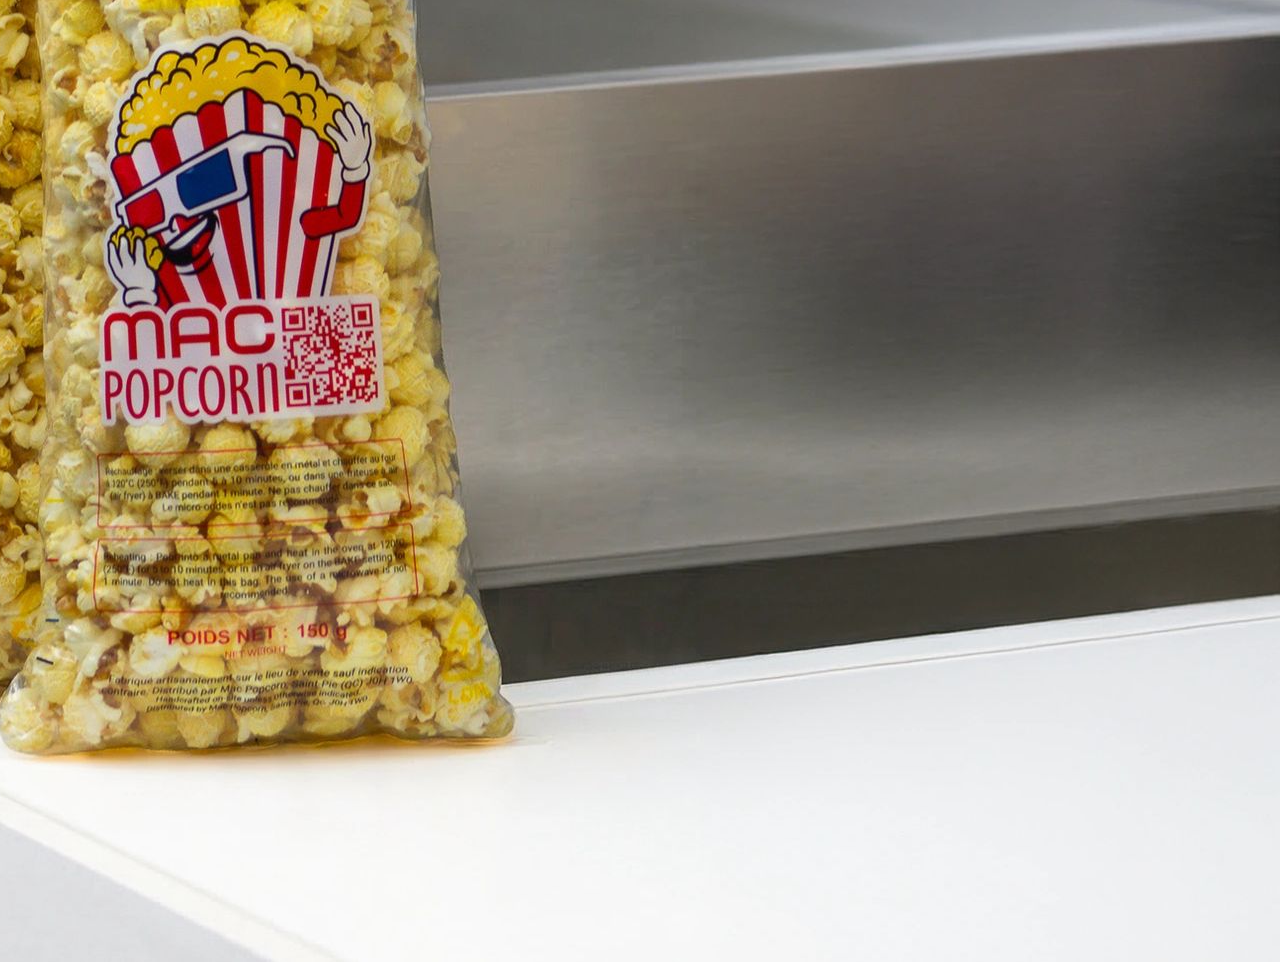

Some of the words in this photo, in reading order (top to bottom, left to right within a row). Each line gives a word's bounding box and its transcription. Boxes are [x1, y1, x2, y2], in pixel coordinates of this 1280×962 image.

[214, 465, 231, 474] une
[280, 461, 294, 471] en
[295, 458, 321, 470] métal
[322, 457, 331, 468] et
[288, 473, 301, 483] ou
[303, 471, 326, 482] dans
[181, 489, 219, 501] pendant
[284, 485, 301, 497] pas
[161, 501, 173, 512] Le
[234, 498, 257, 510] n'est
[286, 546, 308, 558] heat
[311, 546, 321, 557] in
[323, 543, 339, 555] the
[367, 541, 377, 552] at
[239, 564, 249, 574] in
[302, 558, 315, 569] on
[317, 557, 333, 568] the
[148, 576, 161, 587] Do
[183, 575, 204, 587] heat
[207, 576, 216, 586] in
[306, 570, 316, 581] of
[382, 563, 391, 574] is
[393, 562, 408, 573] not
[167, 628, 231, 645] POIDS
[236, 623, 276, 643] NET
[296, 621, 329, 639] 150
[335, 625, 348, 642] g
[254, 671, 263, 681] le
[265, 669, 284, 679] lieu
[285, 667, 299, 677] de
[332, 667, 357, 678] sauf
[357, 665, 409, 676] indication
[200, 686, 218, 697] par
[339, 678, 364, 691] (QC)
